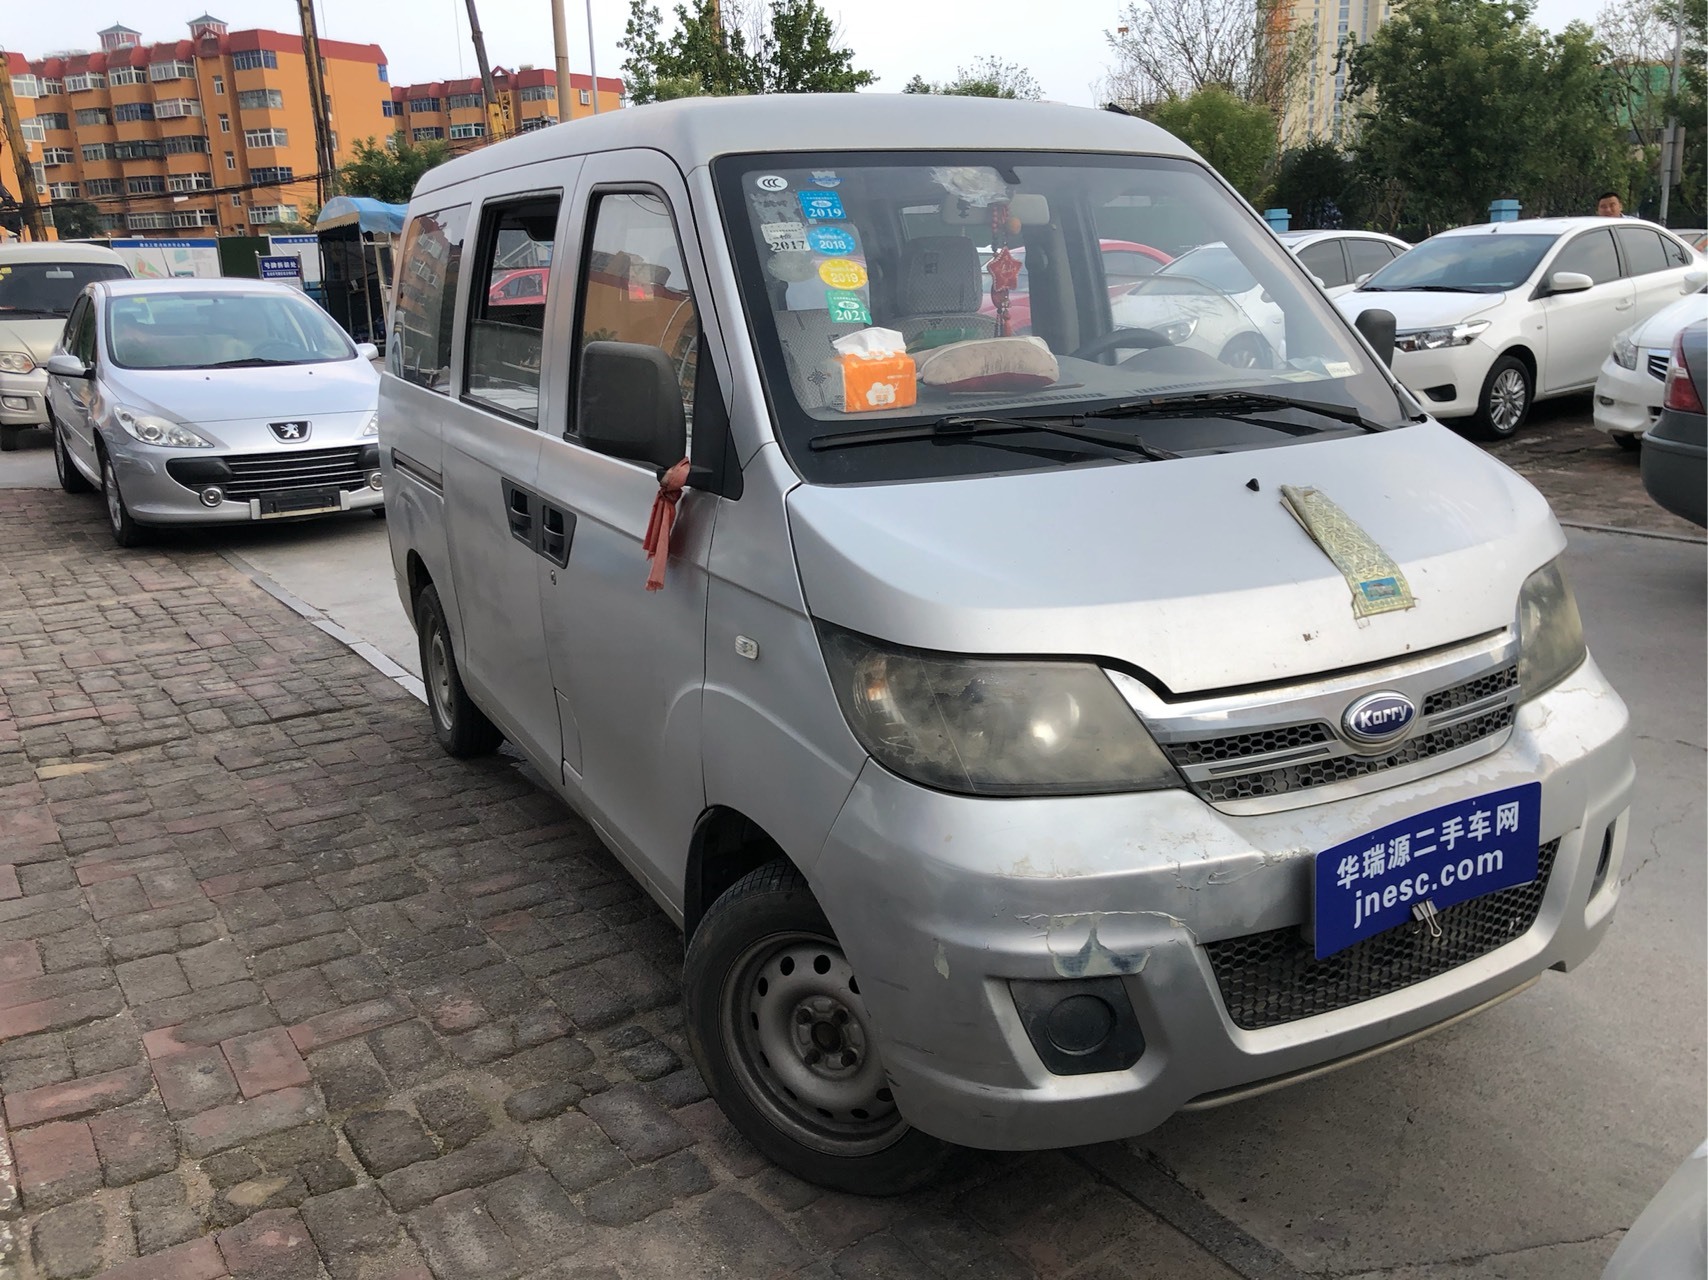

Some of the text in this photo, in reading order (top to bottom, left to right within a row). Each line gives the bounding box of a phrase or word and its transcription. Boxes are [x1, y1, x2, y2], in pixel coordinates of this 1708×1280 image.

[809, 208, 842, 218] 2019
[772, 240, 805, 251] 2017
[819, 240, 846, 250] 2018
[830, 272, 858, 283] 2019
[835, 310, 867, 321] 2021
[1360, 704, 1407, 728] Karry
[1336, 801, 1519, 890] 华瑞源二手车网
[1353, 849, 1504, 929] jnesc.com
